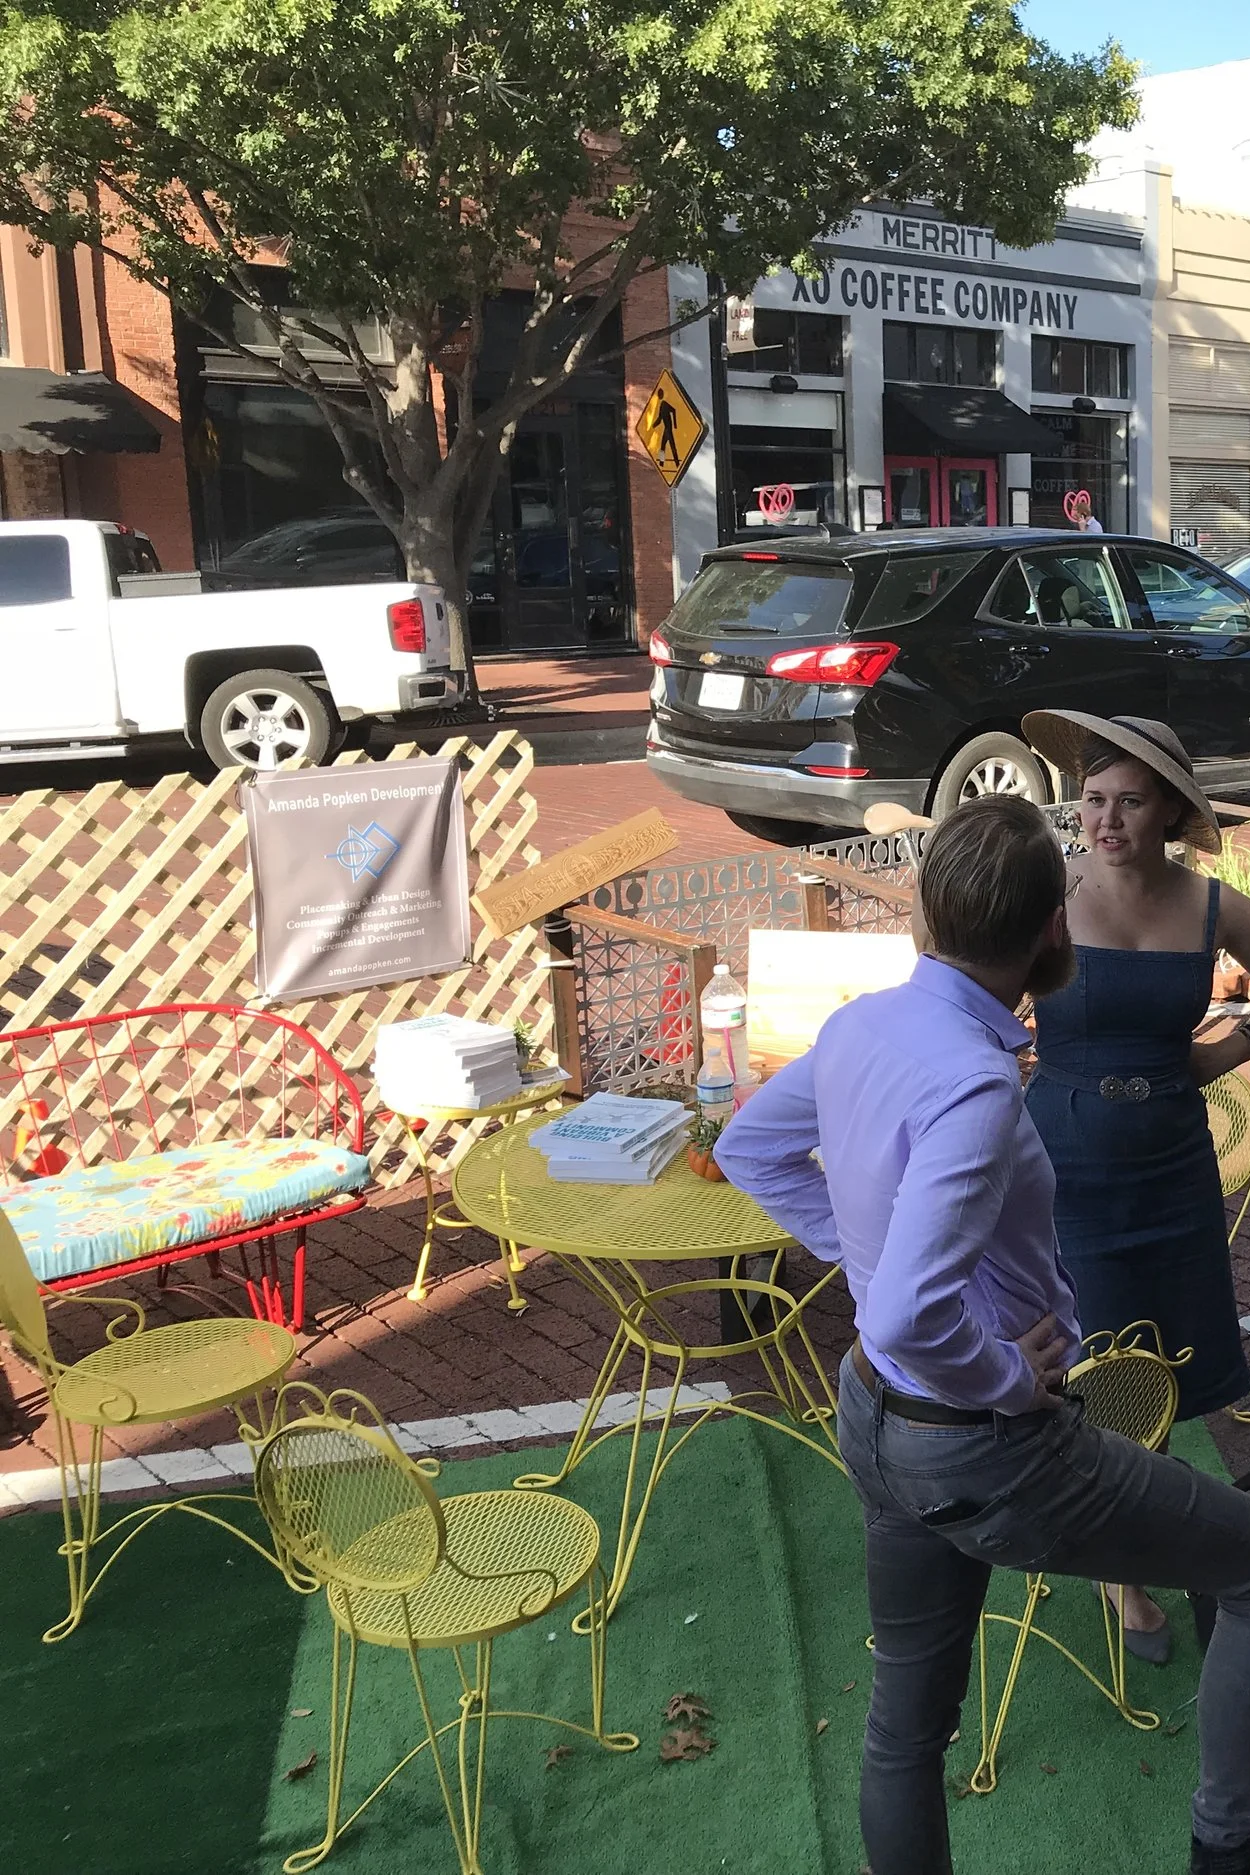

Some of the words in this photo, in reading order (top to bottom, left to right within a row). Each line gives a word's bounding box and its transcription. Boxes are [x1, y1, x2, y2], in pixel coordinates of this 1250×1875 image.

[882, 216, 998, 260] MERRITT
[792, 269, 831, 305] XO
[841, 266, 946, 317] COFFEE
[954, 279, 1078, 330] COMPANY
[268, 795, 320, 812] Amanda
[323, 791, 368, 808] Popken
[300, 898, 361, 915] Placemaking
[371, 893, 399, 904] Urban
[402, 887, 431, 901] Design
[287, 914, 345, 930] Community
[348, 905, 388, 921] Outreach
[390, 905, 398, 915] &
[400, 898, 443, 913] Marketing
[312, 937, 366, 954] Incremental
[368, 927, 425, 945] Development
[317, 926, 350, 941] Popups
[352, 925, 360, 934] &
[361, 916, 420, 933] Engagements
[328, 955, 411, 977] amandapopken.com
[550, 1130, 612, 1143] BUILDING
[552, 1126, 610, 1138] VIBRANT
[553, 1122, 636, 1134] COMMUNITY
